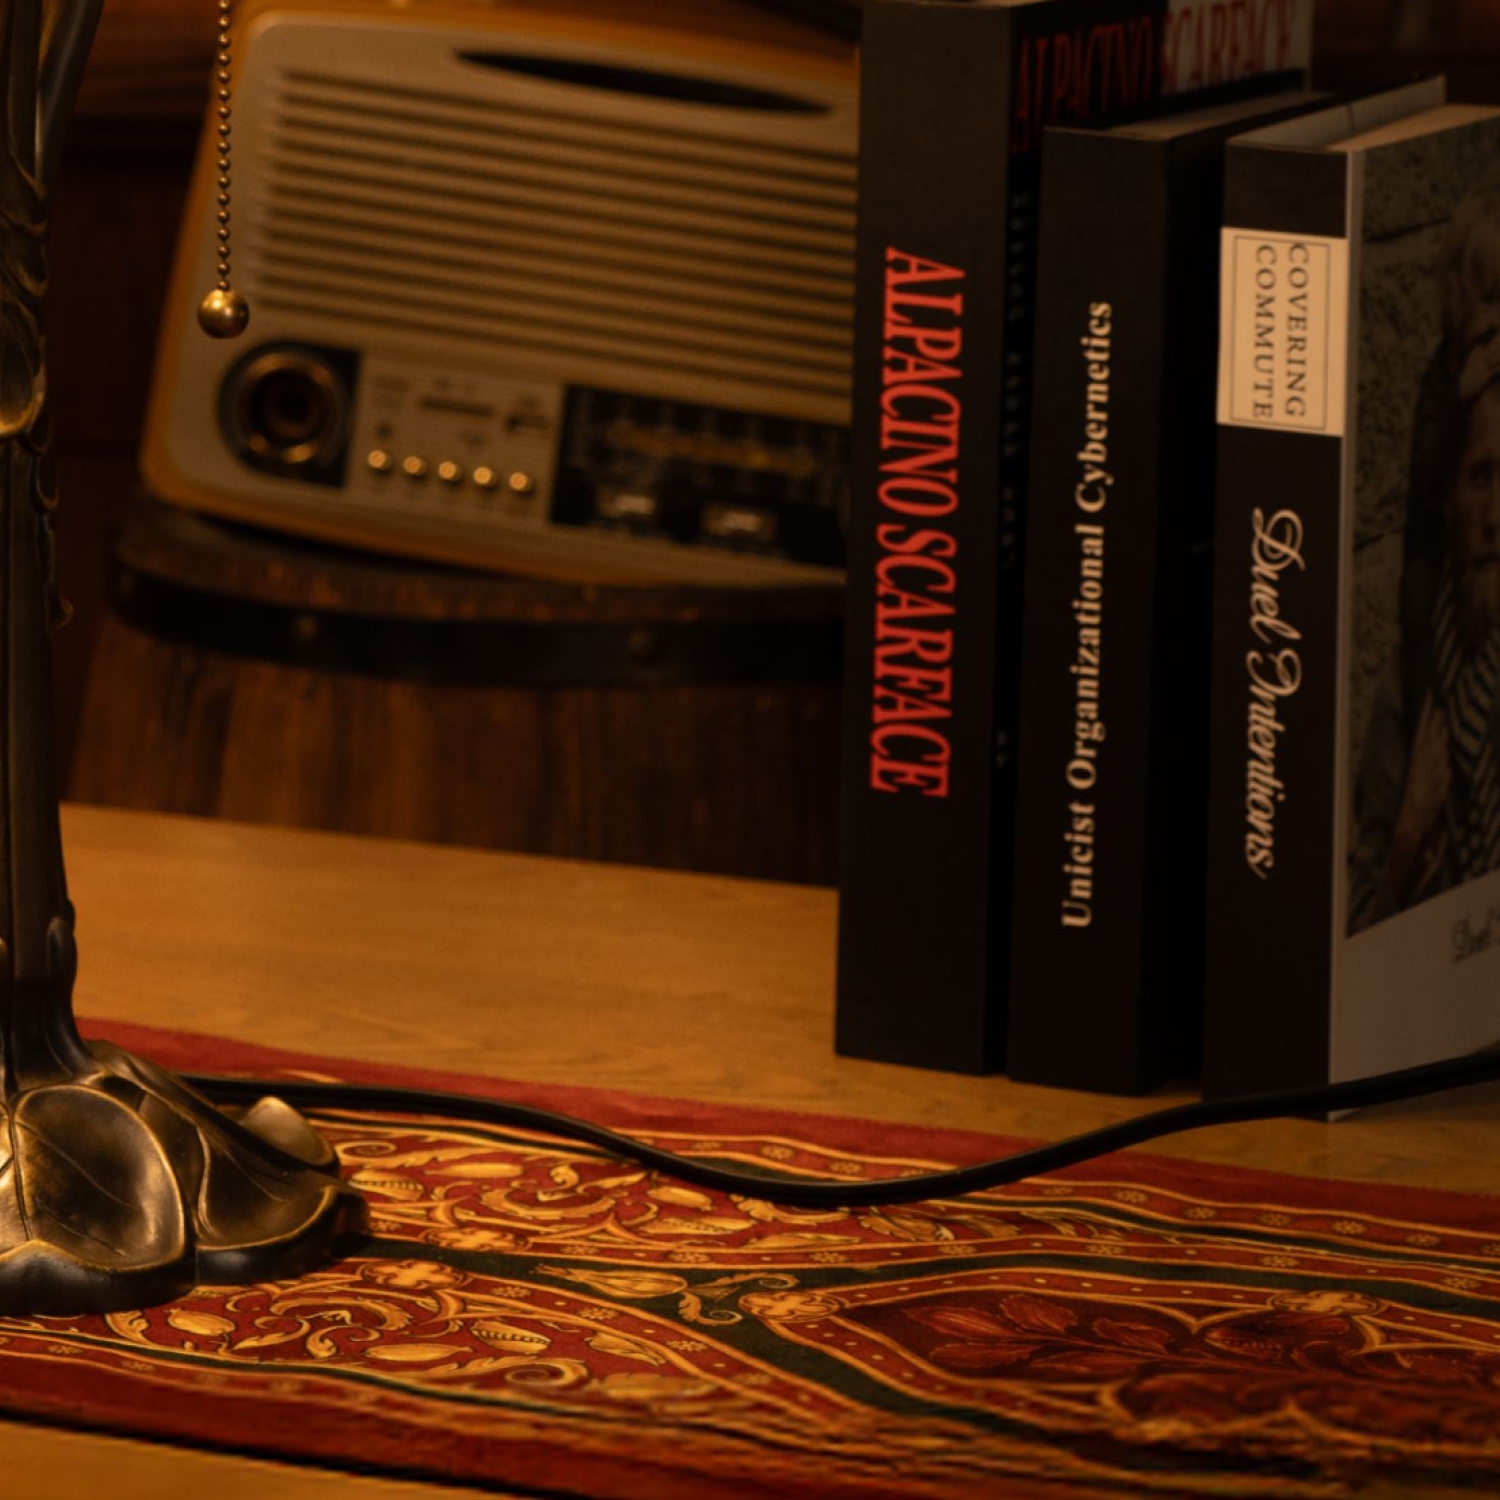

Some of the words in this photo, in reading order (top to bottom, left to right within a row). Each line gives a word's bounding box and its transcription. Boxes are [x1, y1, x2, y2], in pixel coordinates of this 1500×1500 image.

[1075, 301, 1114, 514] Cybernetics
[1253, 244, 1278, 419] COMMUTE
[1285, 243, 1310, 417] COVERING
[869, 521, 959, 799] SCARFACE
[1065, 522, 1106, 791] Organizational
[1248, 506, 1307, 644] Duel
[1243, 646, 1303, 881] Intentions
[1060, 801, 1096, 928] Unicist
